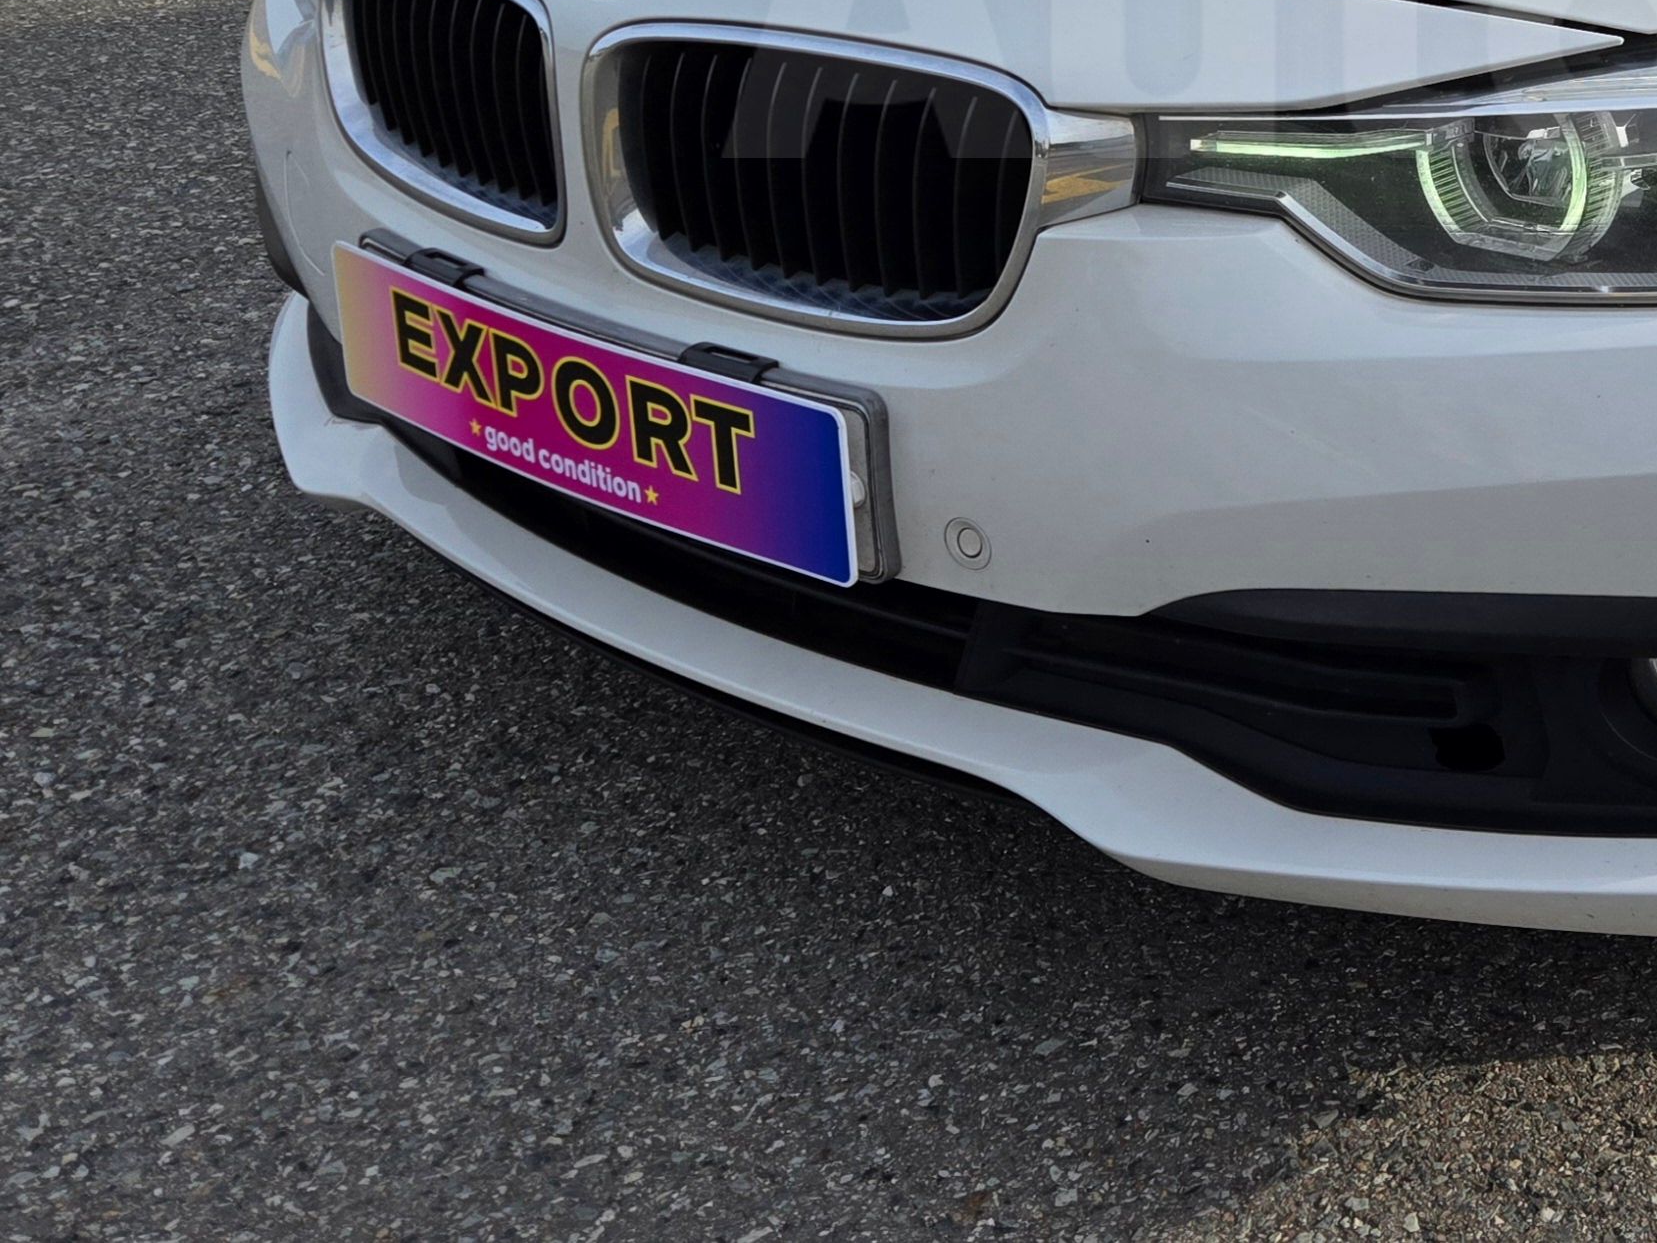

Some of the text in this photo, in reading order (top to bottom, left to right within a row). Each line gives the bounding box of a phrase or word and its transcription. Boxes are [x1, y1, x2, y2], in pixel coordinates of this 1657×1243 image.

[389, 286, 756, 495] EXPORT
[485, 425, 642, 504] good condition
